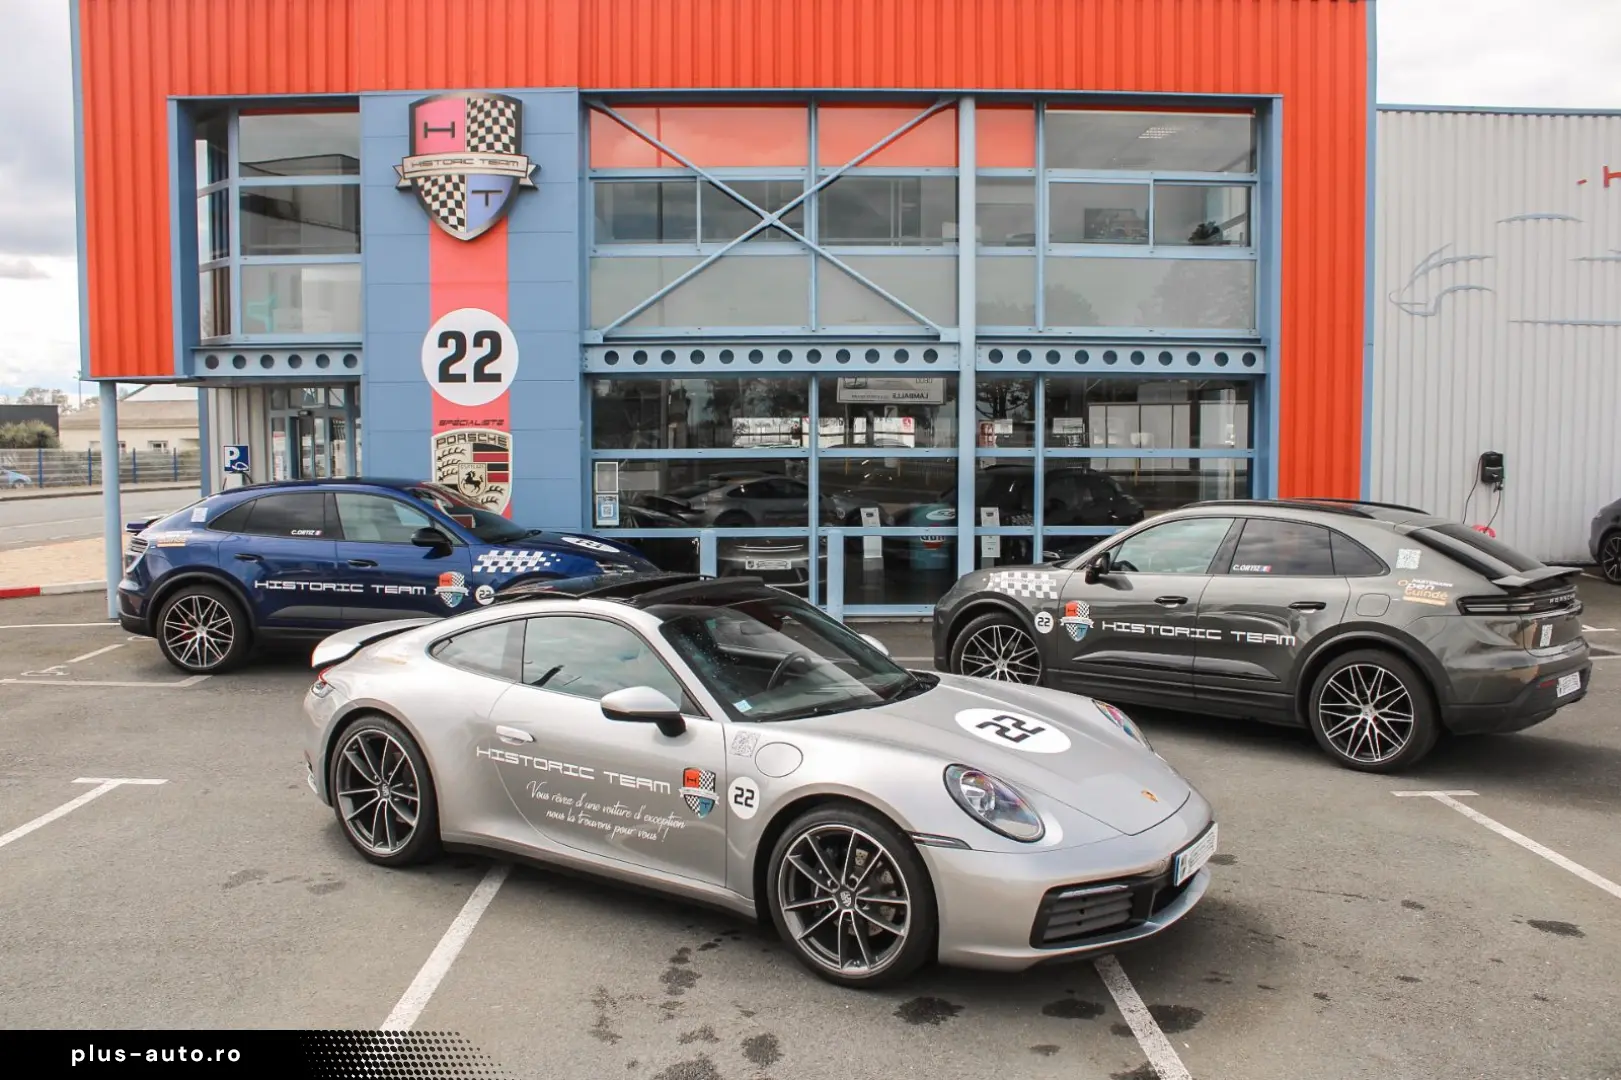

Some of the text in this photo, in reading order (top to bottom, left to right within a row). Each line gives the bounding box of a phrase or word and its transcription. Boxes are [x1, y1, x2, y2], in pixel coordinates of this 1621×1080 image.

[424, 121, 455, 139] H
[479, 158, 520, 167] TEAM
[471, 189, 503, 206] T
[437, 330, 503, 383] 22
[436, 433, 508, 449] PORSCHE
[224, 446, 241, 468] P
[254, 580, 364, 593] HISTORIC
[371, 584, 427, 595] TEAM
[1037, 616, 1051, 627] 22
[1102, 620, 1296, 647] HISTORIC TEAM
[975, 715, 1046, 743] 22
[476, 746, 671, 794] HISTORIC TEAM
[526, 780, 549, 798] Vous
[602, 800, 632, 818] voiture
[733, 786, 755, 808] 22
[546, 810, 566, 821] nous
[567, 807, 576, 822] la
[578, 810, 612, 831] trouvons
[611, 825, 636, 840] pour
[638, 830, 657, 841] vous
